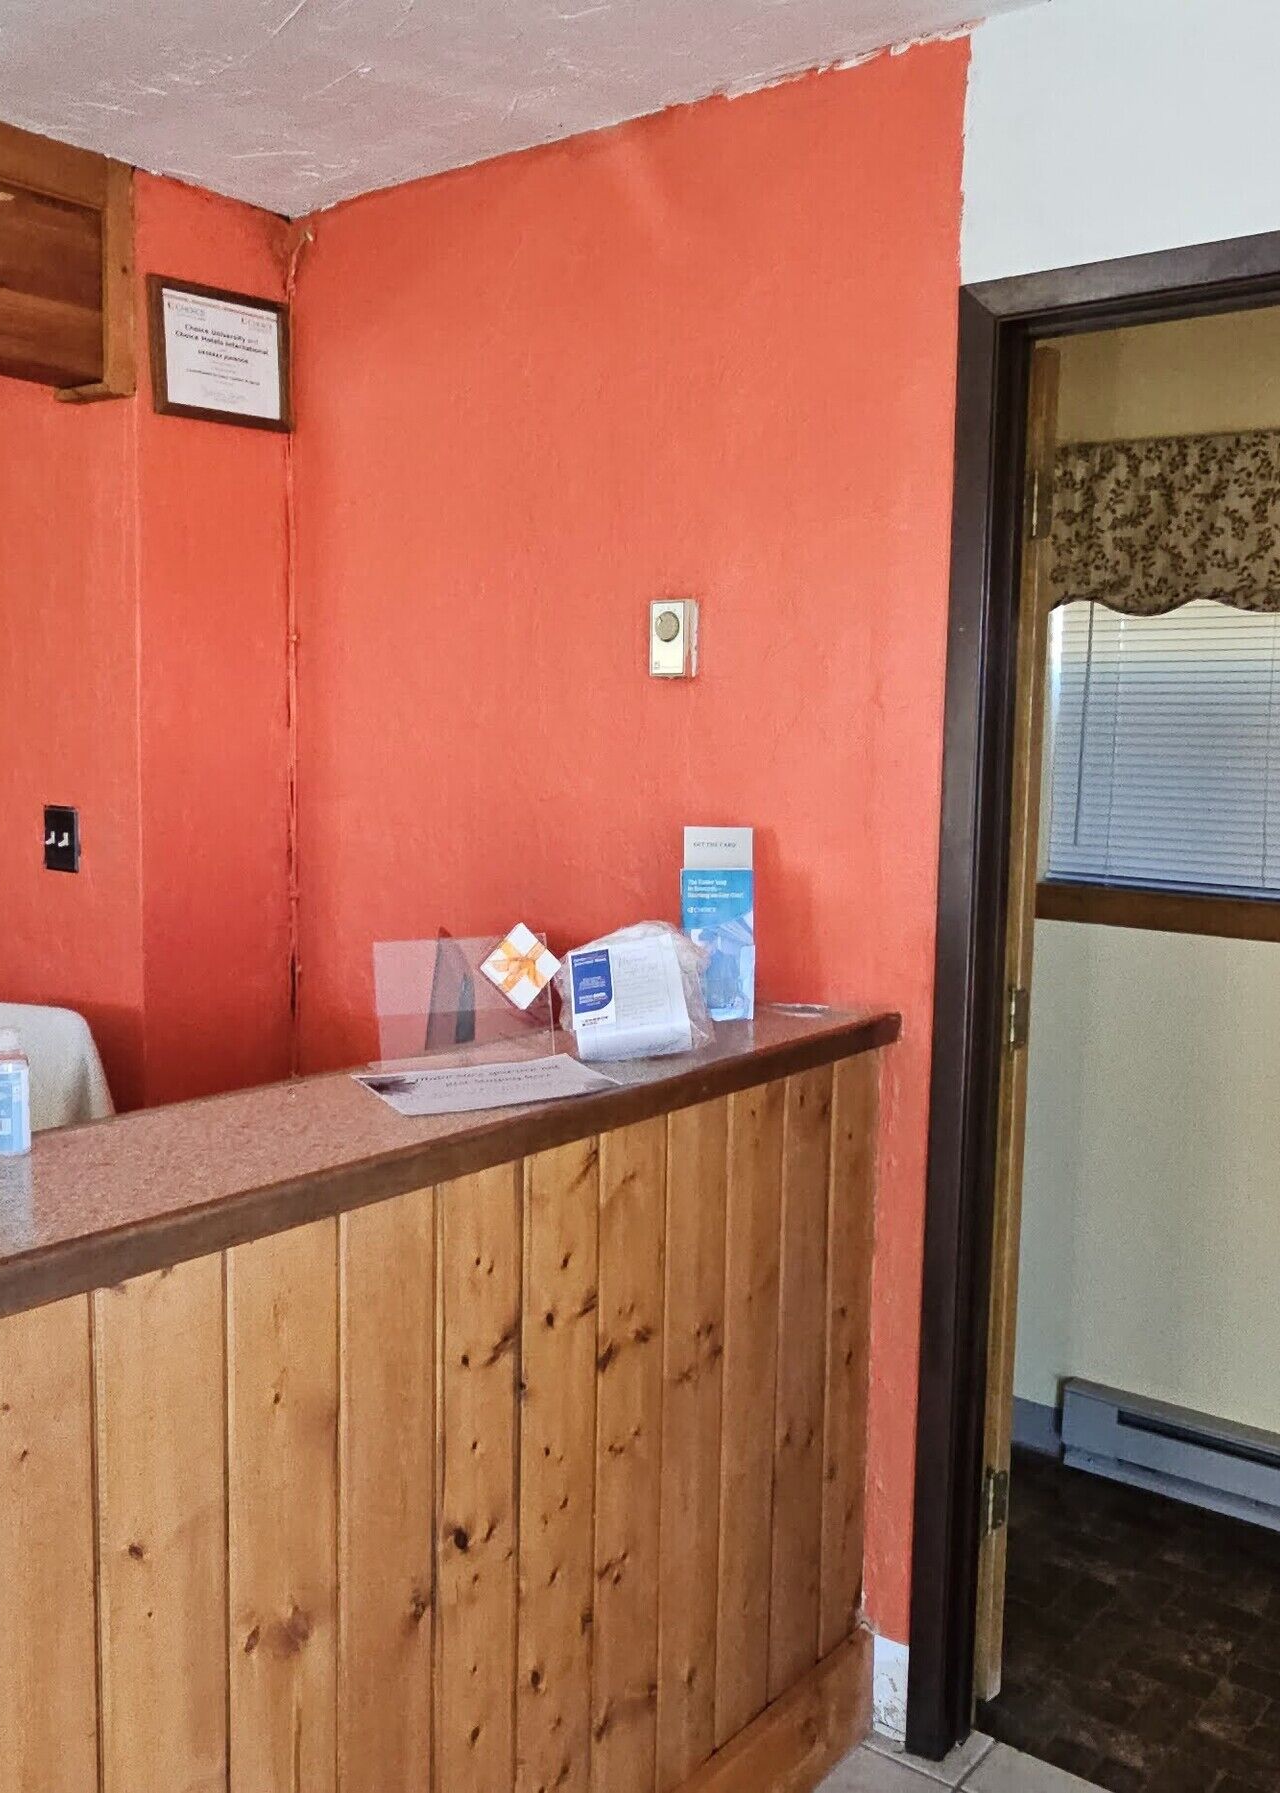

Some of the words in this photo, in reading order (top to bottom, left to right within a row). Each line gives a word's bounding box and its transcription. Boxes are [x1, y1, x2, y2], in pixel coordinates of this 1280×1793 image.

[175, 329, 199, 340] Choice
[184, 323, 209, 334] Choice
[211, 329, 246, 342] University
